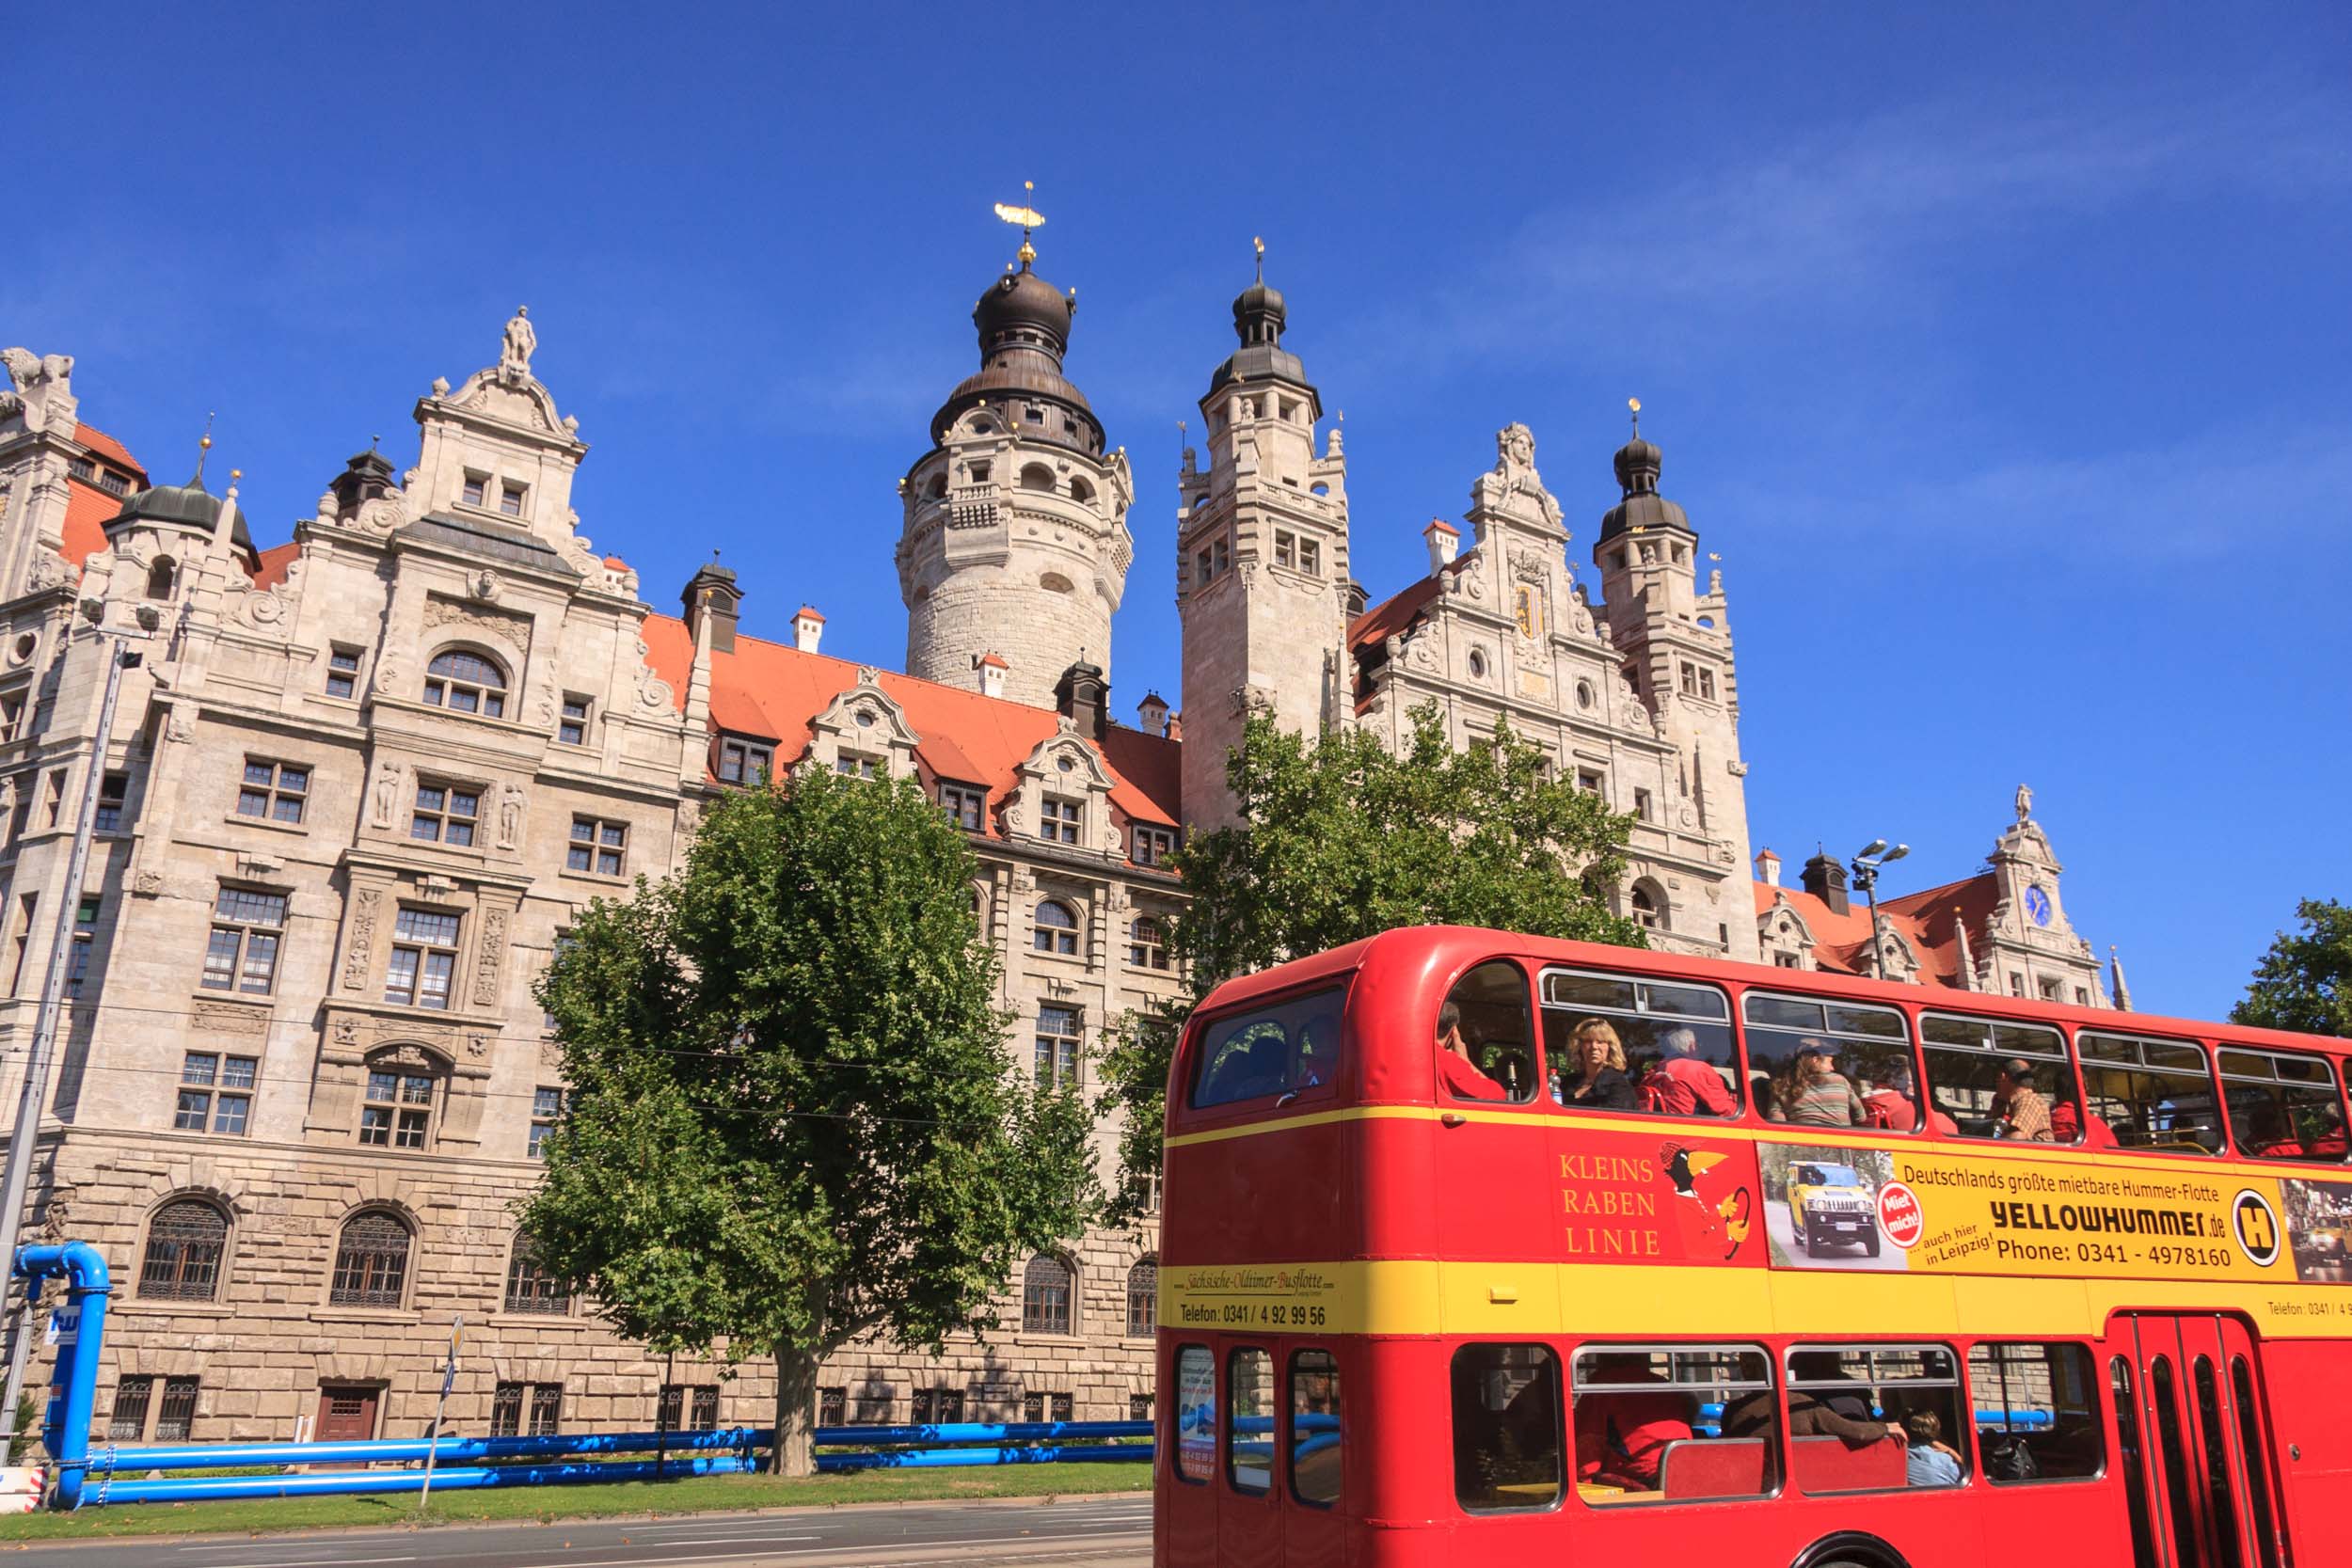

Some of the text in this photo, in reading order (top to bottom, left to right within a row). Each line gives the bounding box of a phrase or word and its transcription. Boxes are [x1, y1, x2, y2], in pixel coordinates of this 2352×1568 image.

[1559, 1154, 1654, 1182] KLEINS
[1903, 1164, 2219, 1202] Deutschlands größte mietbare Hummer-Flotte
[1563, 1189, 1655, 1216] RABEN
[1884, 1193, 1912, 1212] Miet
[1888, 1211, 1920, 1234] mich!
[1565, 1227, 1661, 1256] LINIE
[1923, 1230, 1952, 1250] auch
[1954, 1224, 1978, 1240] hier
[1926, 1231, 1995, 1266] in Leipzig!
[1996, 1239, 2071, 1261] Phone:
[2077, 1243, 2128, 1263] 0341
[2149, 1245, 2232, 1268] 4978160
[1181, 1304, 1221, 1323] Telefon:
[1272, 1306, 1286, 1324] 92
[1291, 1306, 1306, 1325] 99
[1310, 1306, 1326, 1326] 56
[2267, 1301, 2307, 1316] Telefon:
